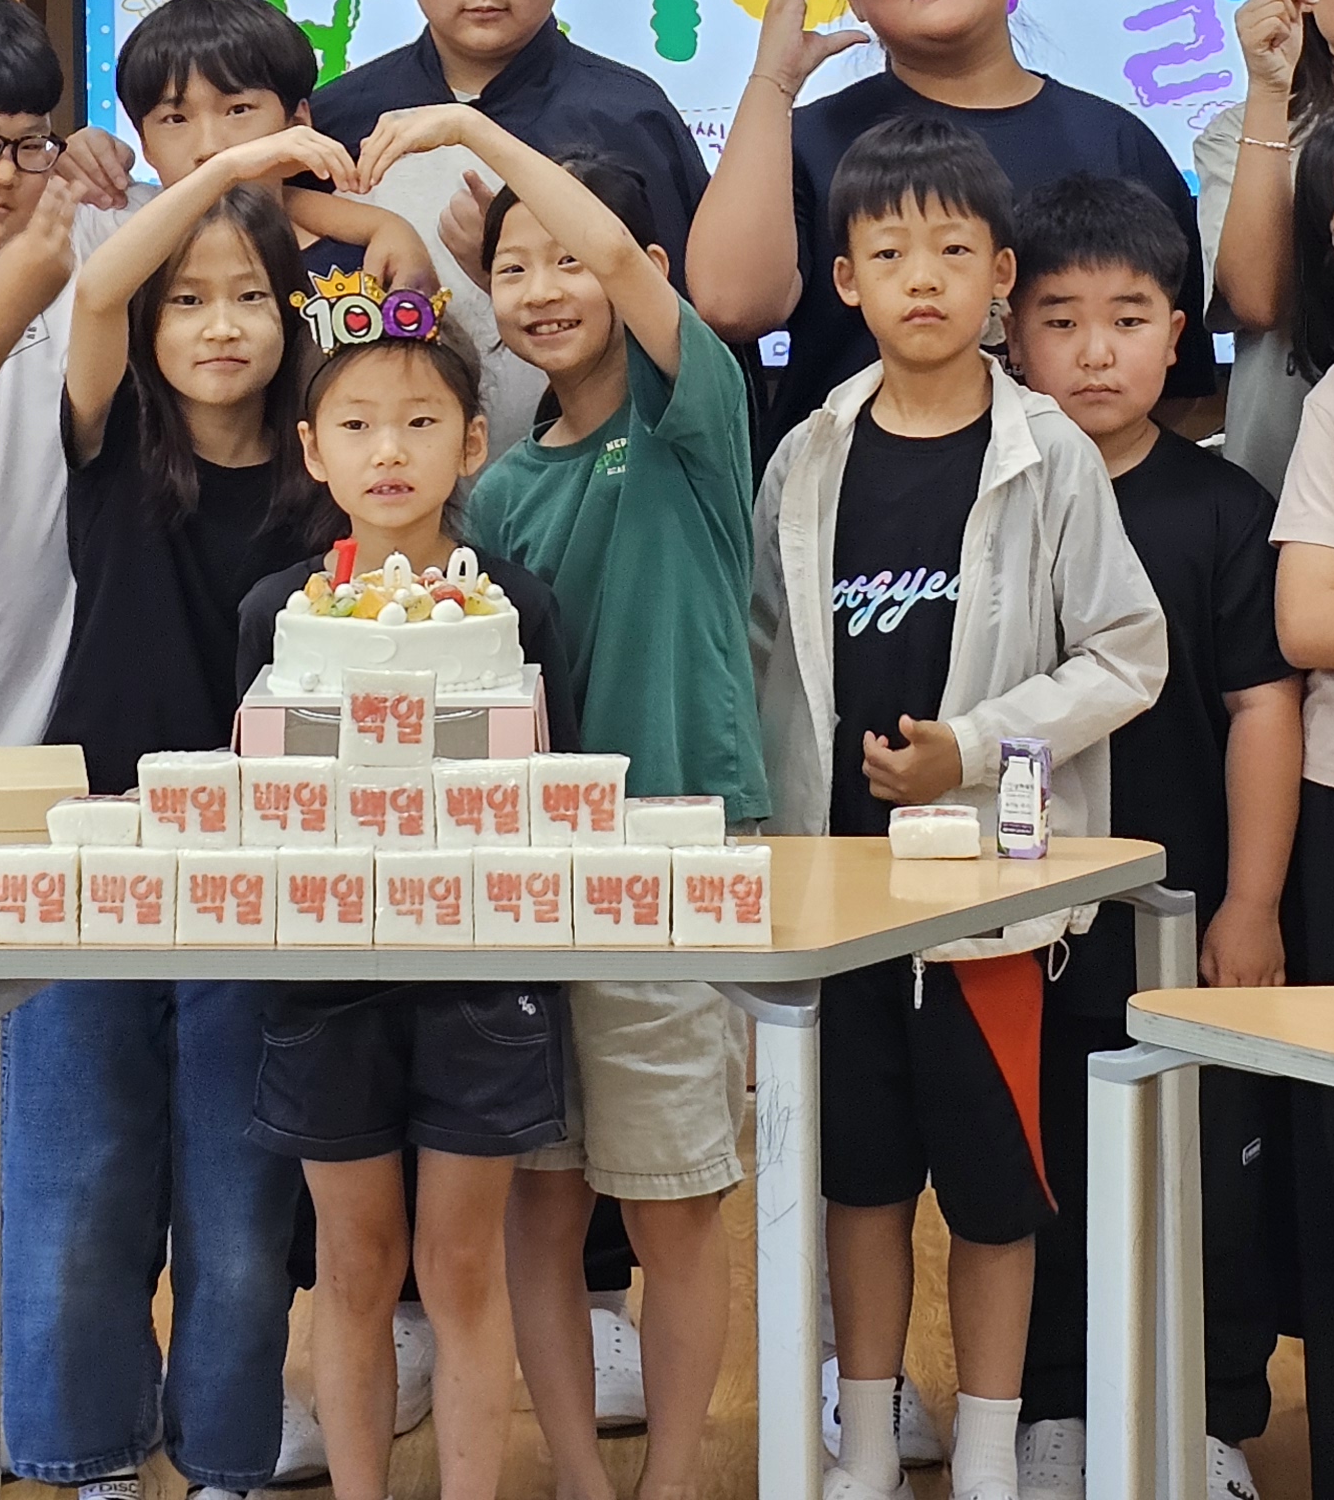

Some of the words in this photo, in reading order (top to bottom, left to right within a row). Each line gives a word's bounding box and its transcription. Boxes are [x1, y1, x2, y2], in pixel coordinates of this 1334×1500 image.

[301, 289, 435, 350] 100
[350, 692, 424, 745] 백일
[149, 784, 227, 833] 백일
[252, 781, 328, 832] 백일
[349, 786, 424, 836] 백일
[445, 783, 520, 834] 백일
[541, 781, 617, 833] 백일
[89, 873, 164, 925] 백일
[189, 872, 264, 925] 백일
[288, 872, 364, 924] 백일
[388, 874, 462, 926] 백일
[486, 872, 561, 924] 백일
[585, 874, 660, 926] 백일
[685, 872, 764, 924] 백일
